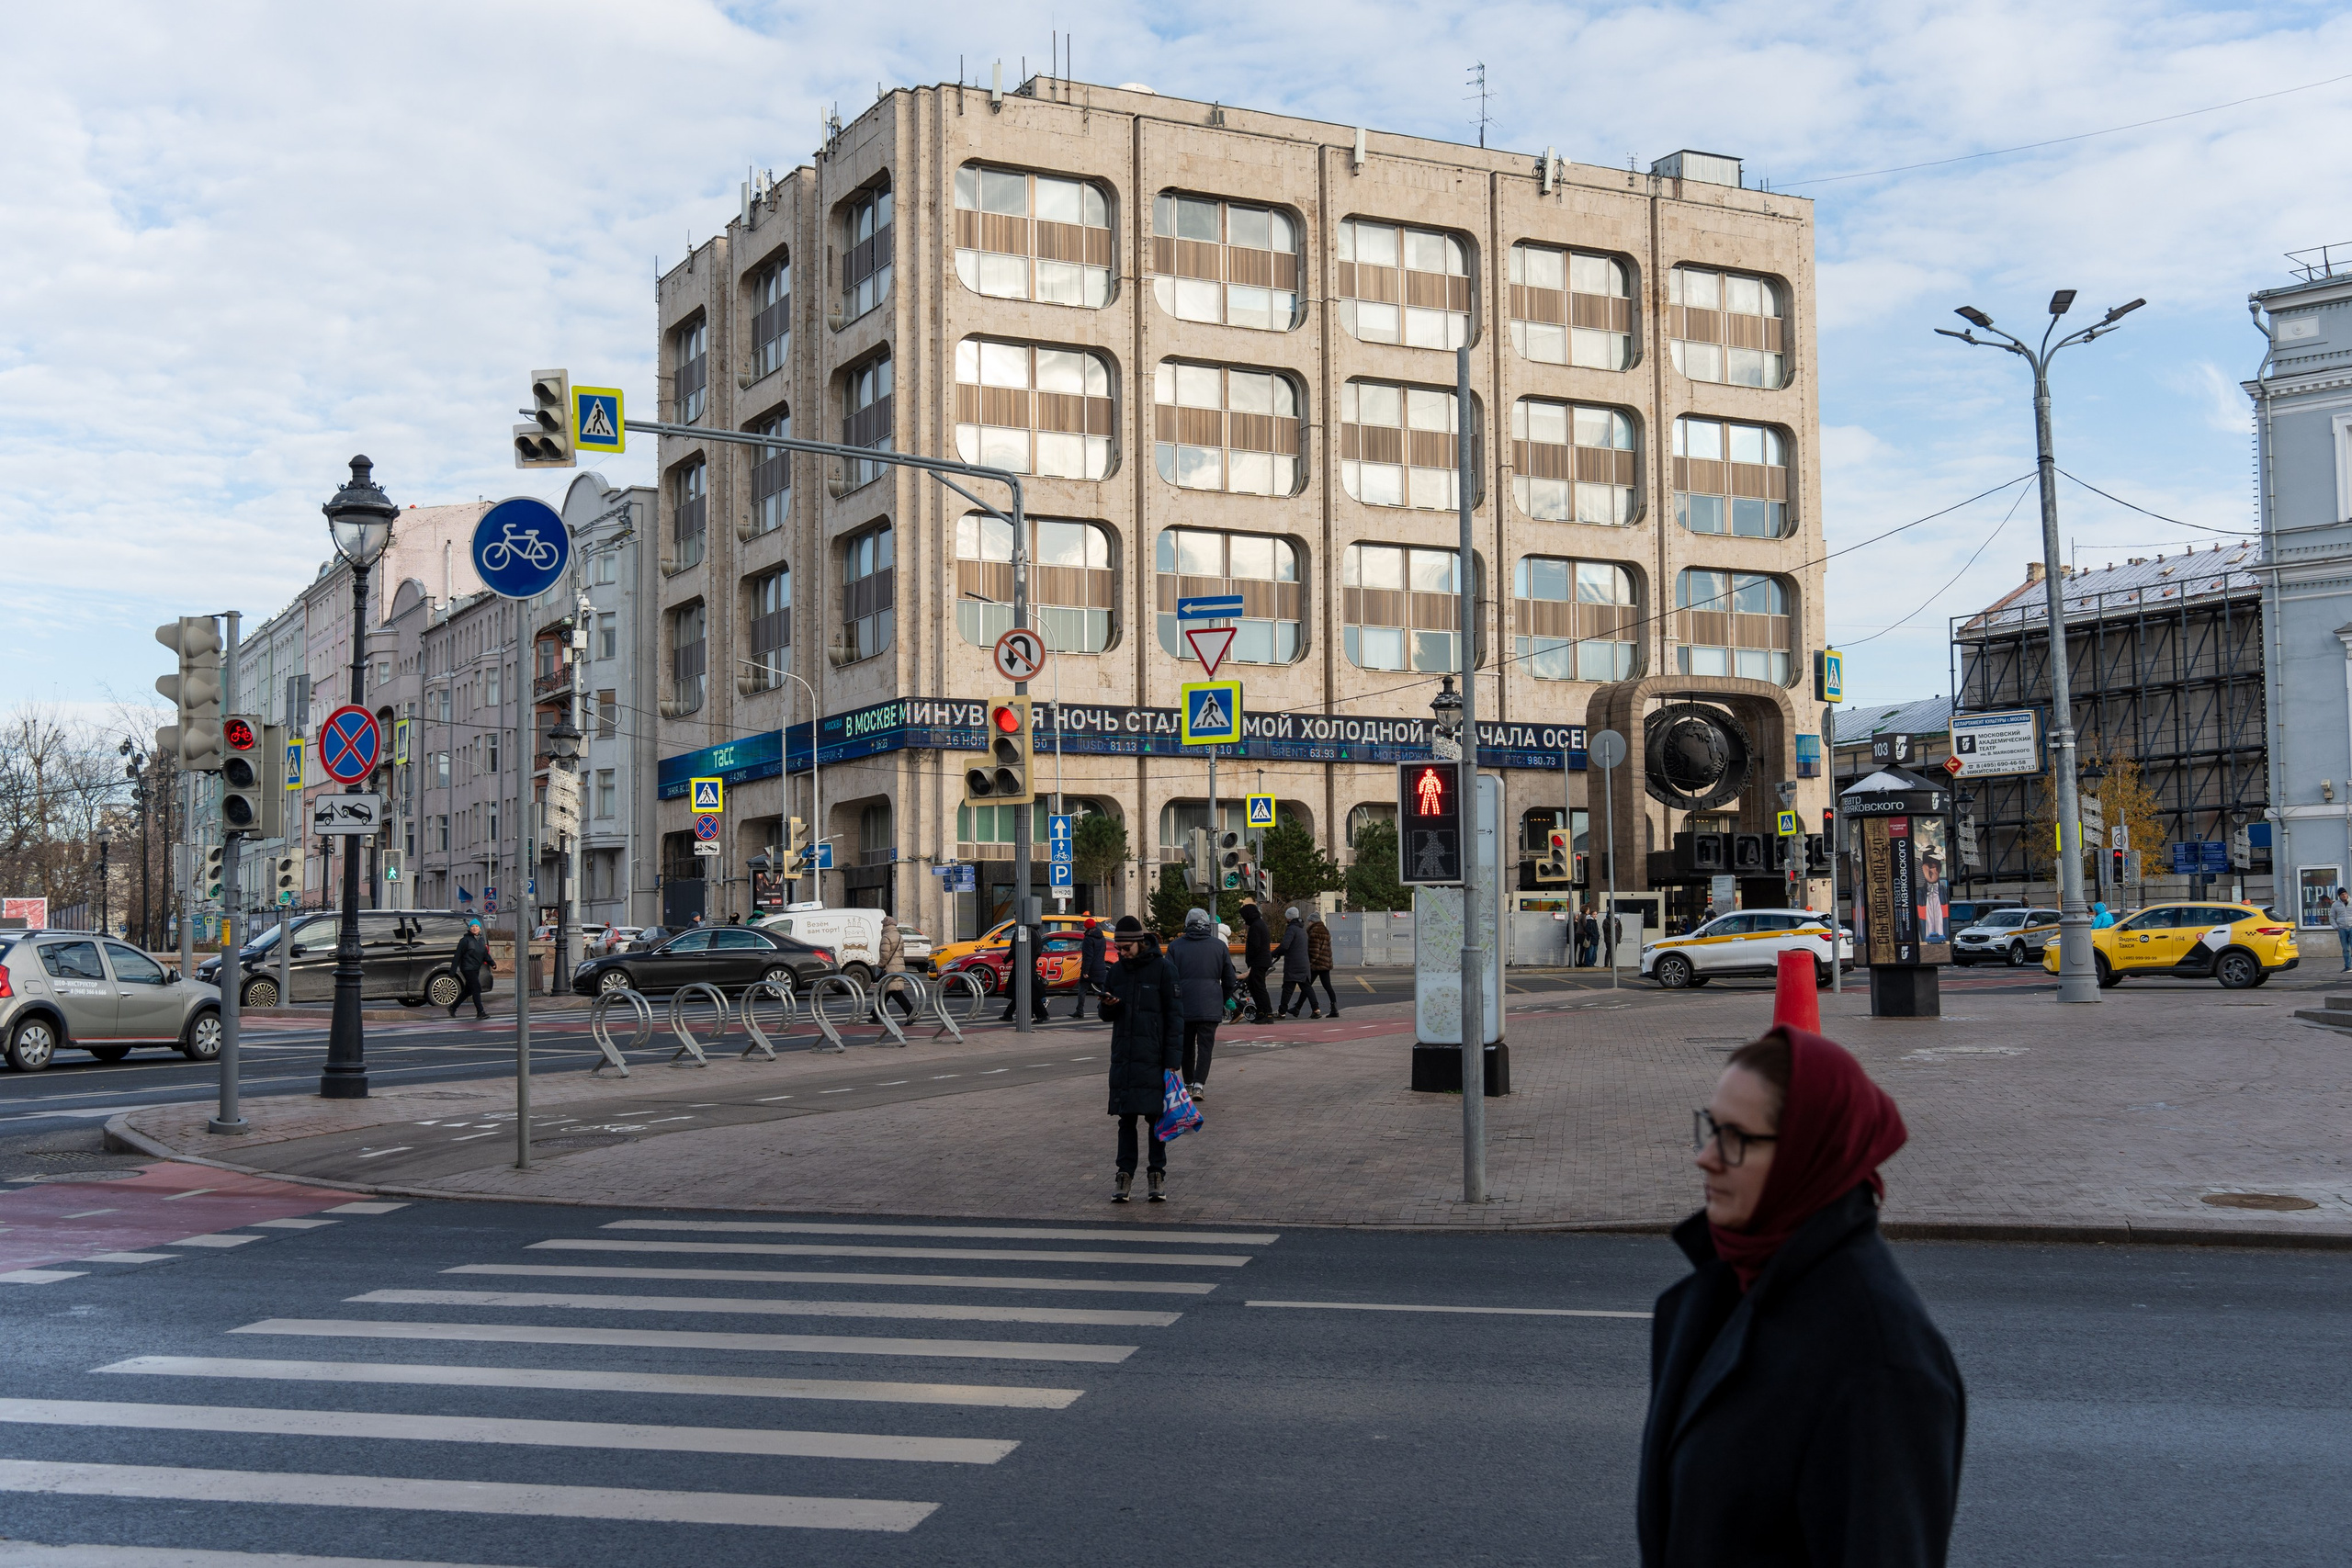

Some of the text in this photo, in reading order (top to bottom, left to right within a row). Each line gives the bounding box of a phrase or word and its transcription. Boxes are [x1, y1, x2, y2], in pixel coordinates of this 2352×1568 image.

[824, 719, 842, 731] МОСКВА
[846, 716, 853, 737] В
[855, 705, 897, 735] МОСКВЕ
[1054, 708, 1119, 731] НОЧЬ
[1125, 712, 1182, 734] СТАЛ
[1301, 718, 1423, 745] ХОЛОДНОЙ
[1452, 726, 1537, 748] НЧАЛА
[1544, 728, 1587, 750] ОСЕ
[1954, 719, 1984, 728] ДЕПАРТАМЕНТ
[1978, 729, 2020, 739] МОСКОВСКИЙ
[1978, 735, 2031, 745] АКАДЕМИЧЕСКИЙ
[945, 735, 959, 746] 16
[1082, 739, 1137, 751] USD: 81.13
[1205, 745, 1232, 755] 9.10
[1272, 747, 1335, 759] BRENT: 63.93
[1874, 742, 1888, 757] 103
[1527, 756, 1556, 766] 980.73
[1056, 865, 1069, 884] P
[1873, 858, 1887, 883] ОТЦА
[2302, 886, 2336, 903] ТРИ
[1874, 887, 1889, 918] МОЕГО
[2303, 908, 2331, 917] МУШКЕТЕ
[822, 926, 840, 934] торт!
[1876, 923, 1890, 945] СНЫ
[1036, 956, 1063, 980] 95
